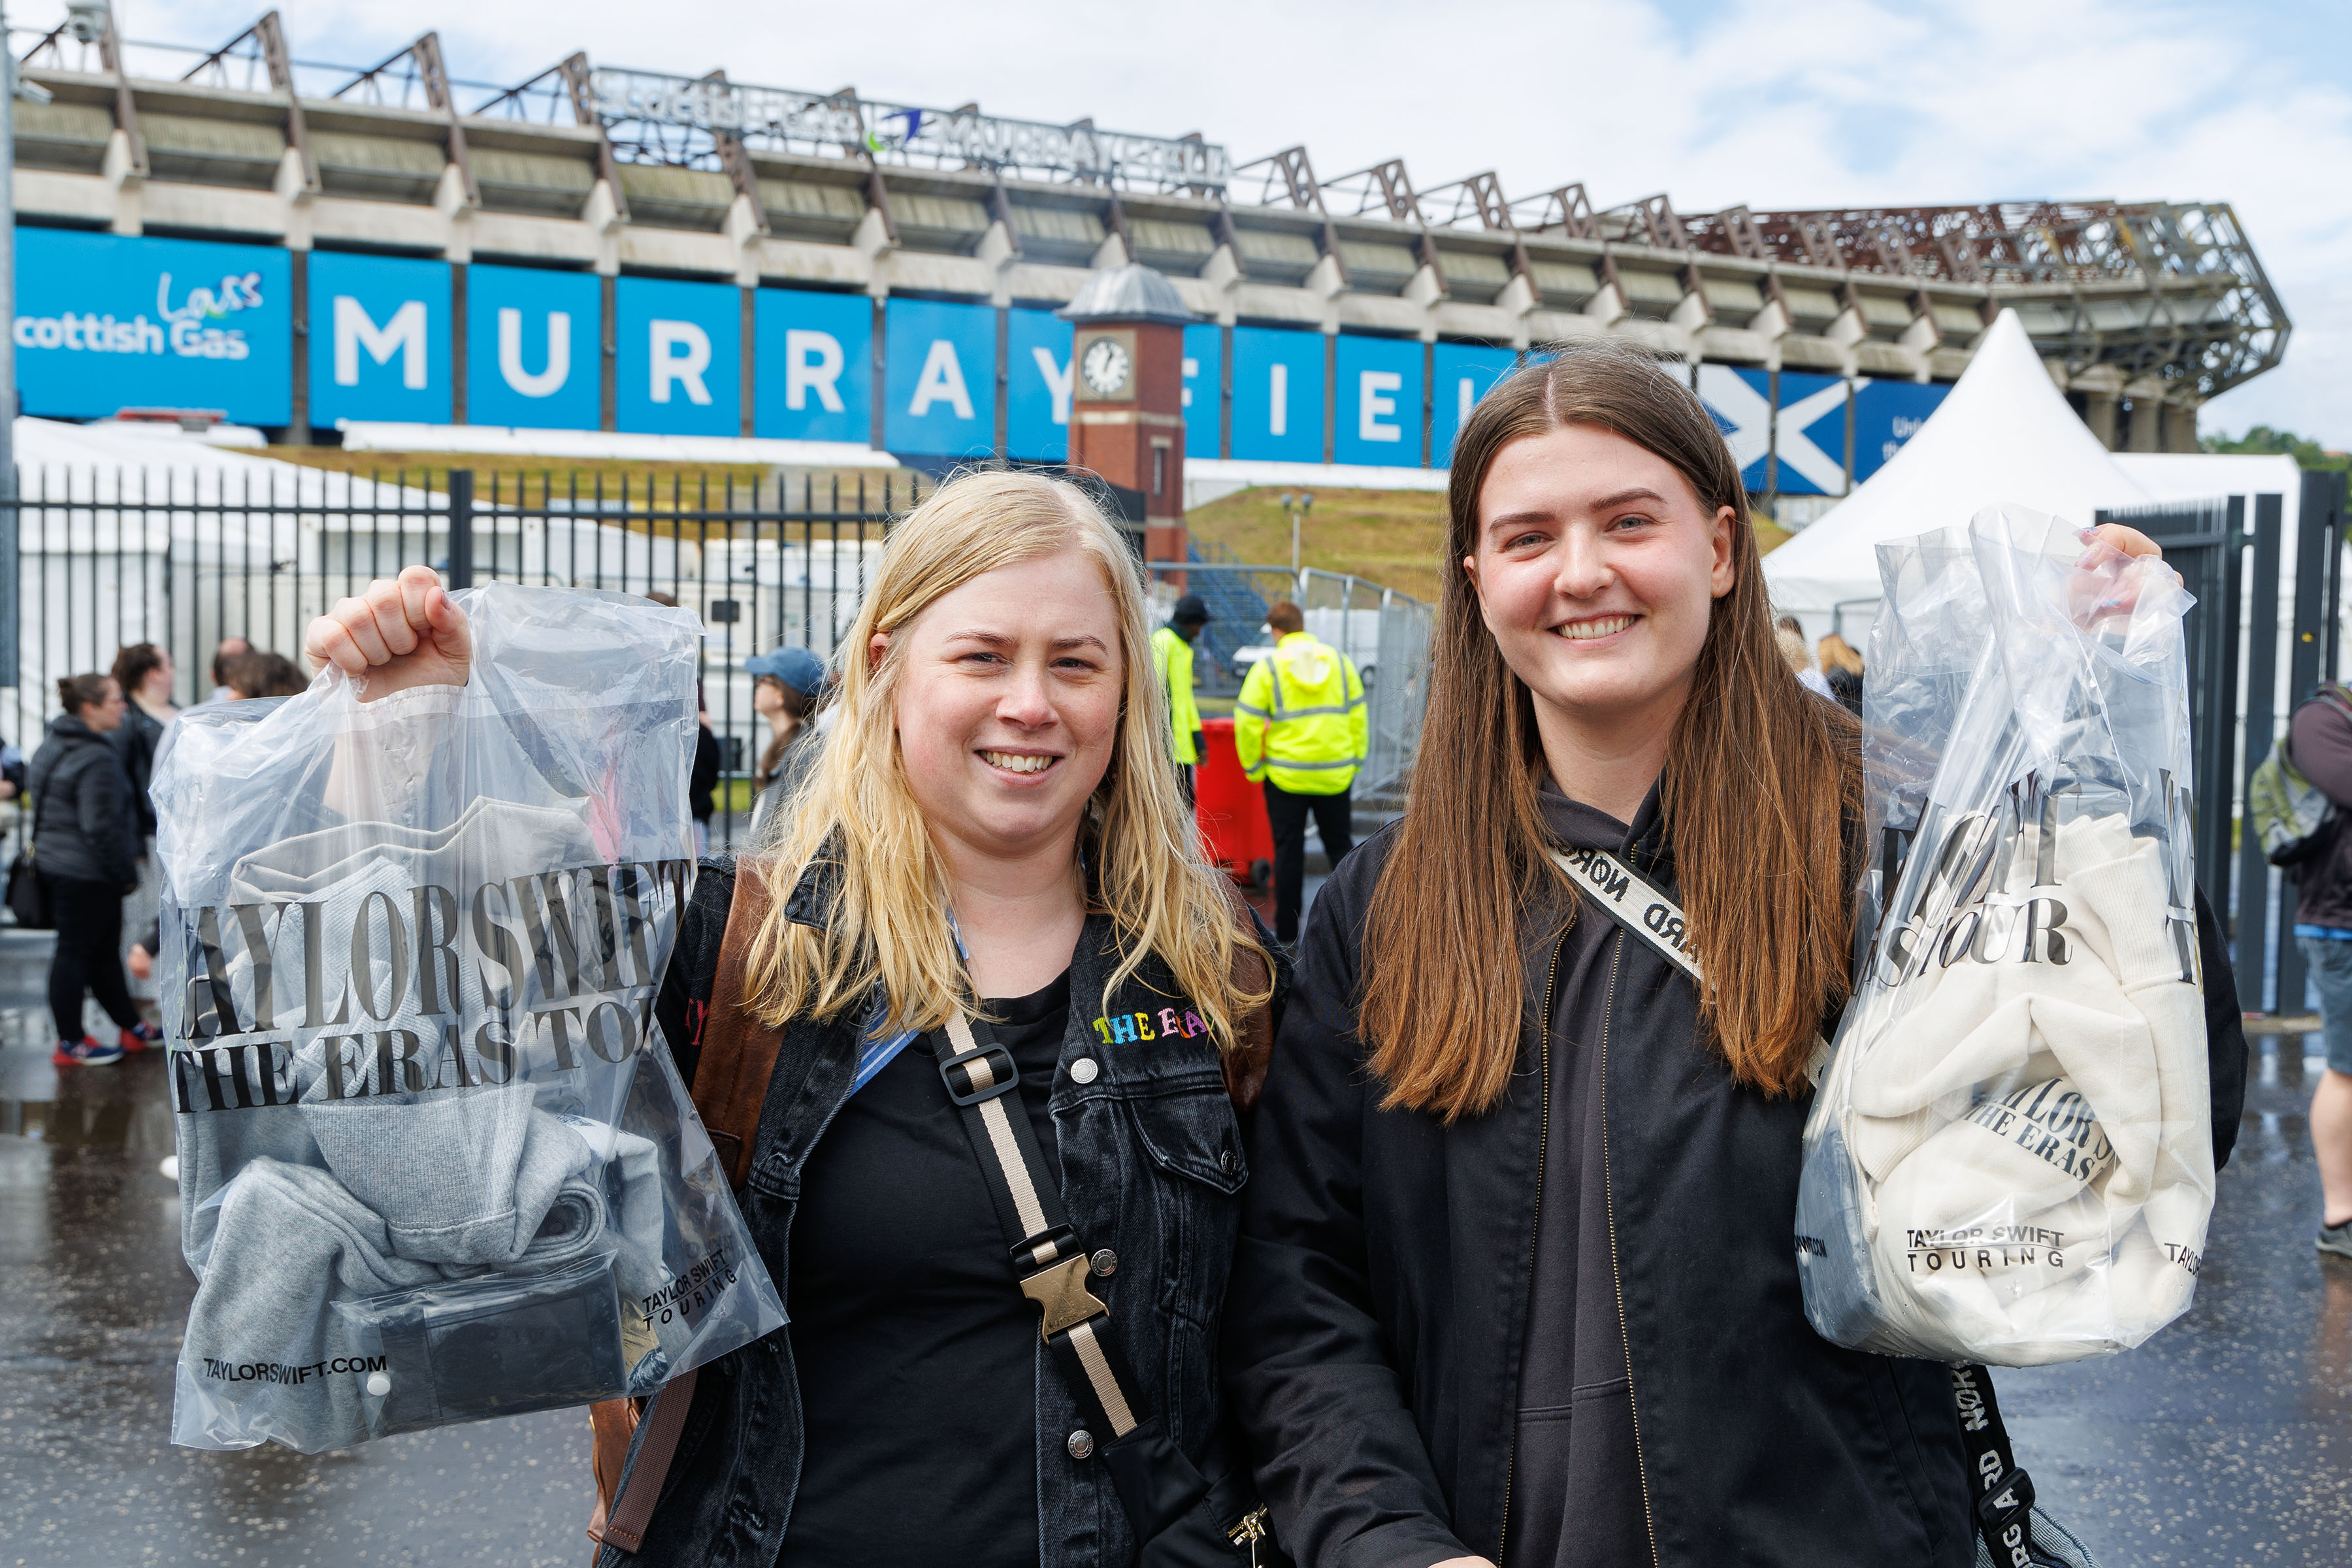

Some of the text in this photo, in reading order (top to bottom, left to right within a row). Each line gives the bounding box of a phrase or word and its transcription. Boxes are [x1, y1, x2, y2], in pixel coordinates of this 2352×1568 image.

[13, 311, 250, 360] cottish Gas
[176, 885, 464, 1039] AYLOR
[1092, 1012, 1156, 1045] THE
[169, 1040, 299, 1113] THE
[318, 1018, 519, 1102] ERAS
[2013, 1122, 2096, 1181] ERAS
[1906, 1226, 2065, 1247] TAYLOR SWIFT
[1907, 1248, 2064, 1272] TOURING
[642, 1249, 727, 1313] TAYLOR SWIFT
[643, 1269, 738, 1332] TOURING
[203, 1355, 387, 1384] TAYLORSWIFT.COM
